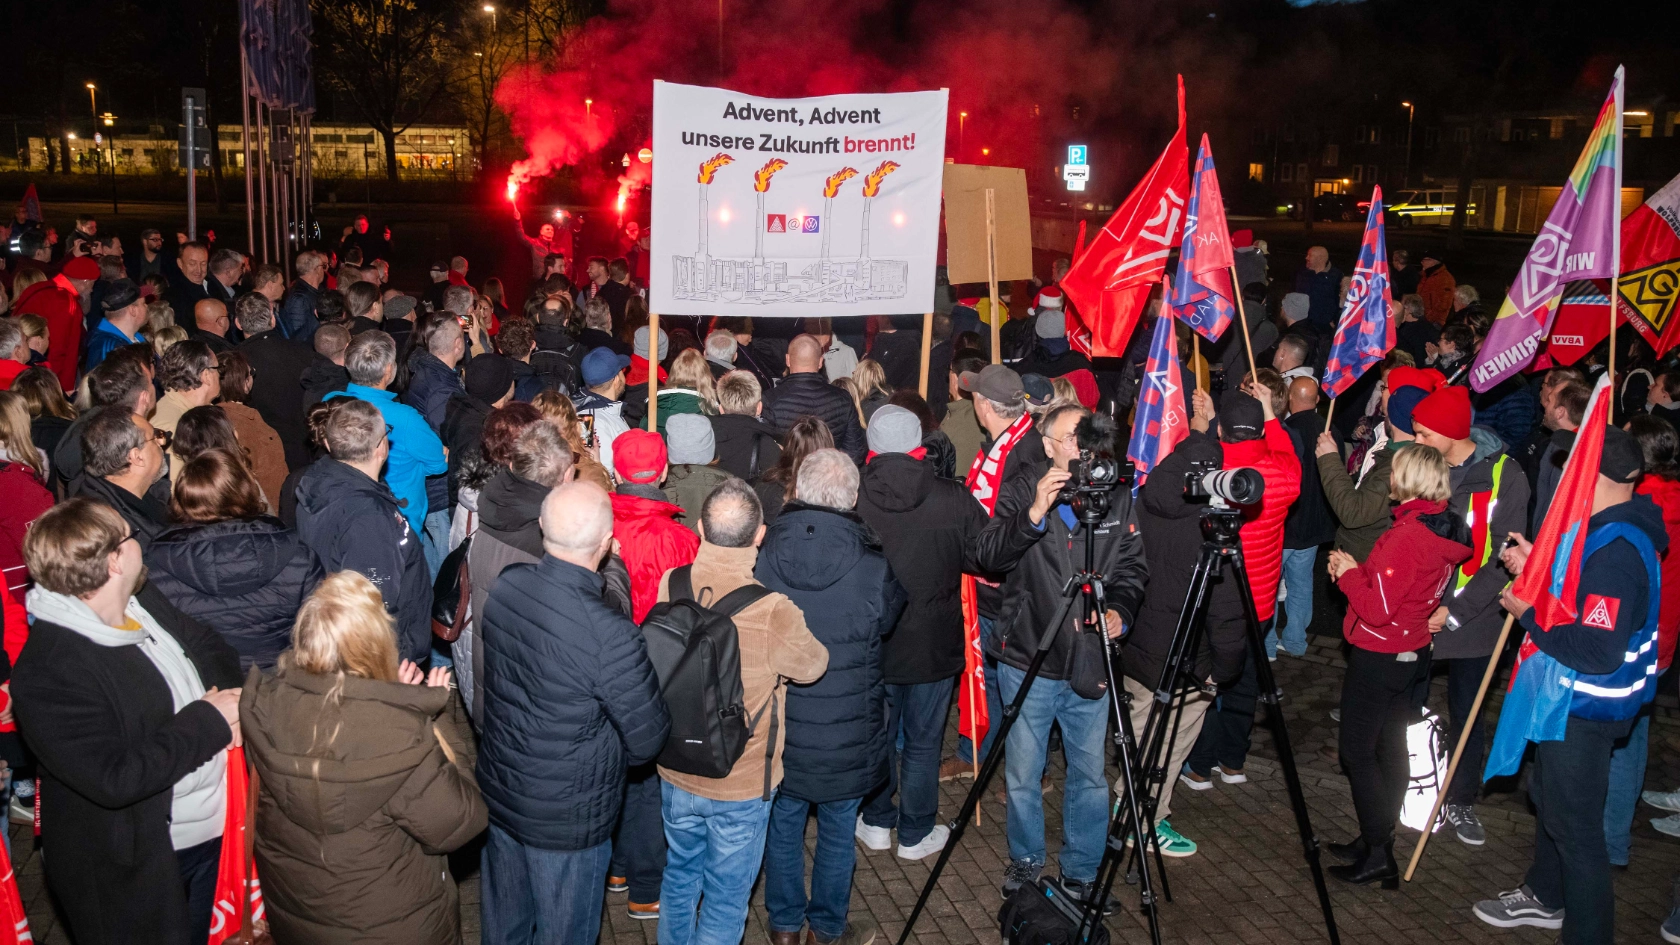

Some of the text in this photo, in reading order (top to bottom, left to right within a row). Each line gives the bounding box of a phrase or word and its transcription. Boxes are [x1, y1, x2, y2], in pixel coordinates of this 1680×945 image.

[722, 101, 881, 126] Advent, Advent
[681, 131, 916, 154] unsere Zukunft brennt!
[1071, 148, 1082, 164] P
[1614, 297, 1648, 334] LFSBURG
